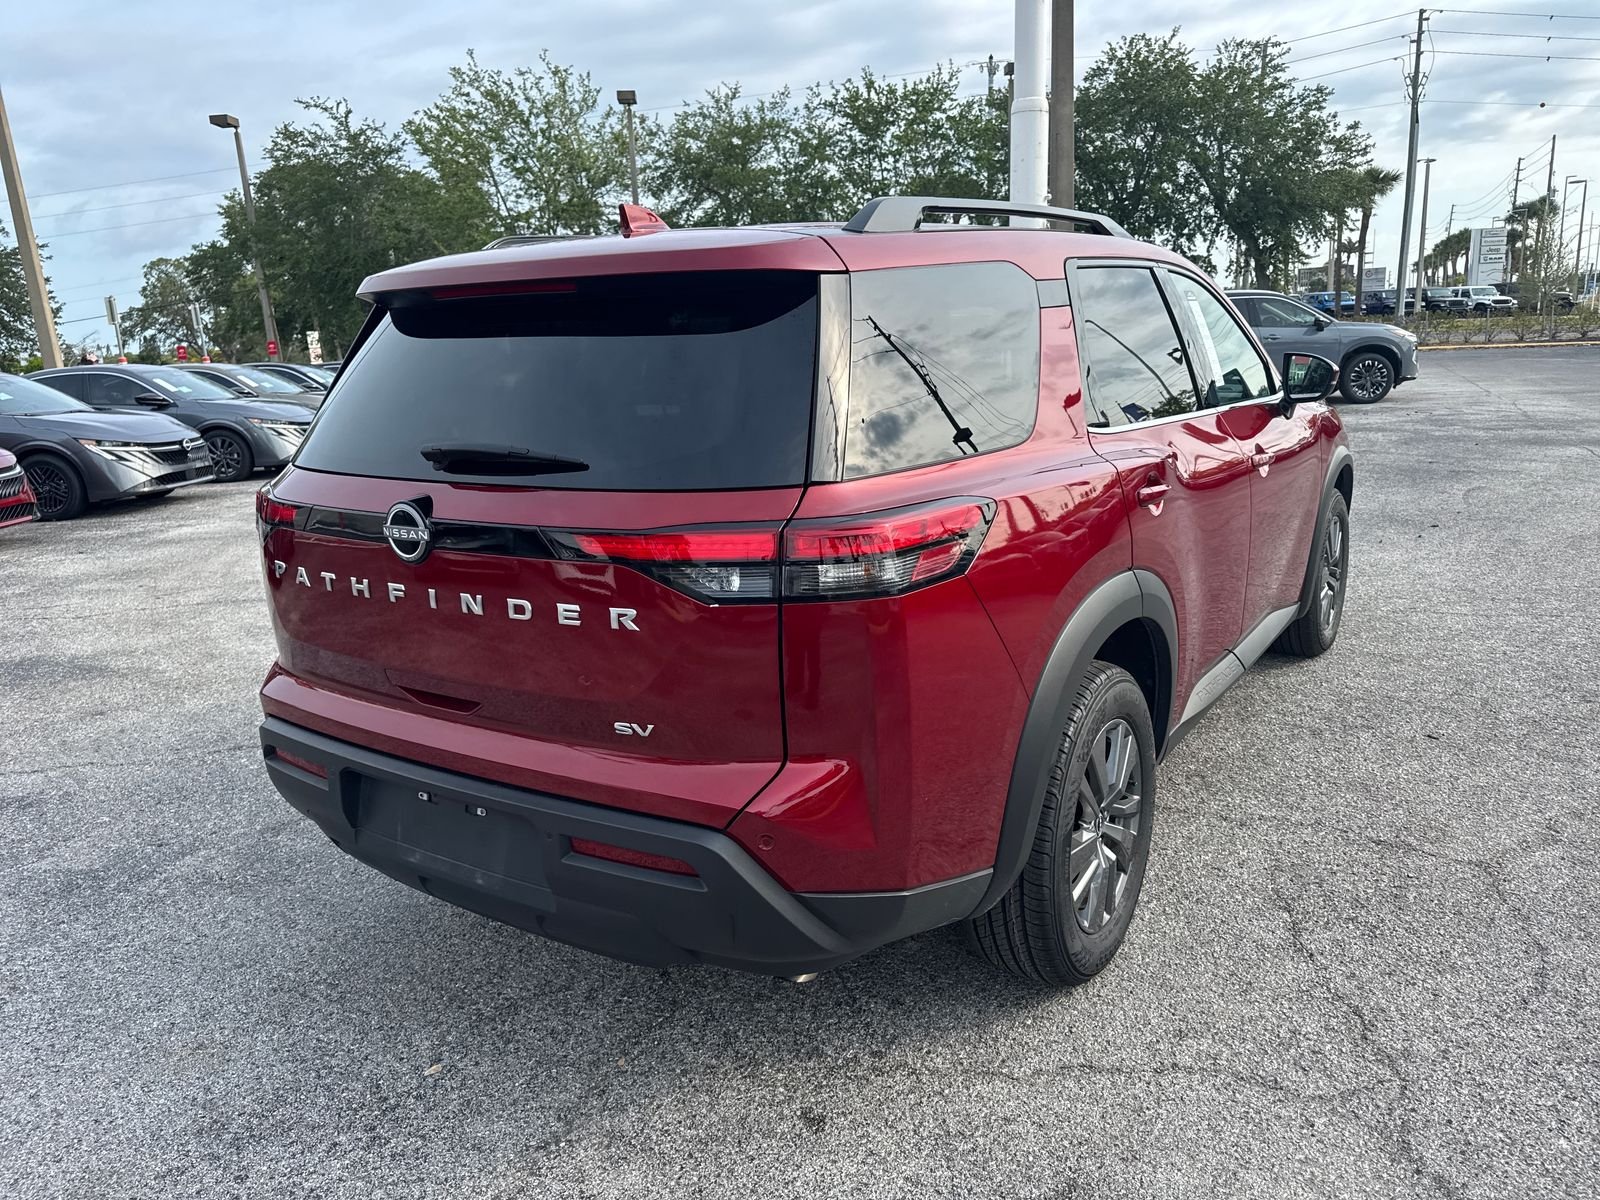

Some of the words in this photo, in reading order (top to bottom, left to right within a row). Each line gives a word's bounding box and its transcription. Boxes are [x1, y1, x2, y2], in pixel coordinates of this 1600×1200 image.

[383, 526, 428, 540] NISSAN
[273, 559, 641, 631] PATHFINDER
[613, 721, 655, 737] SV
